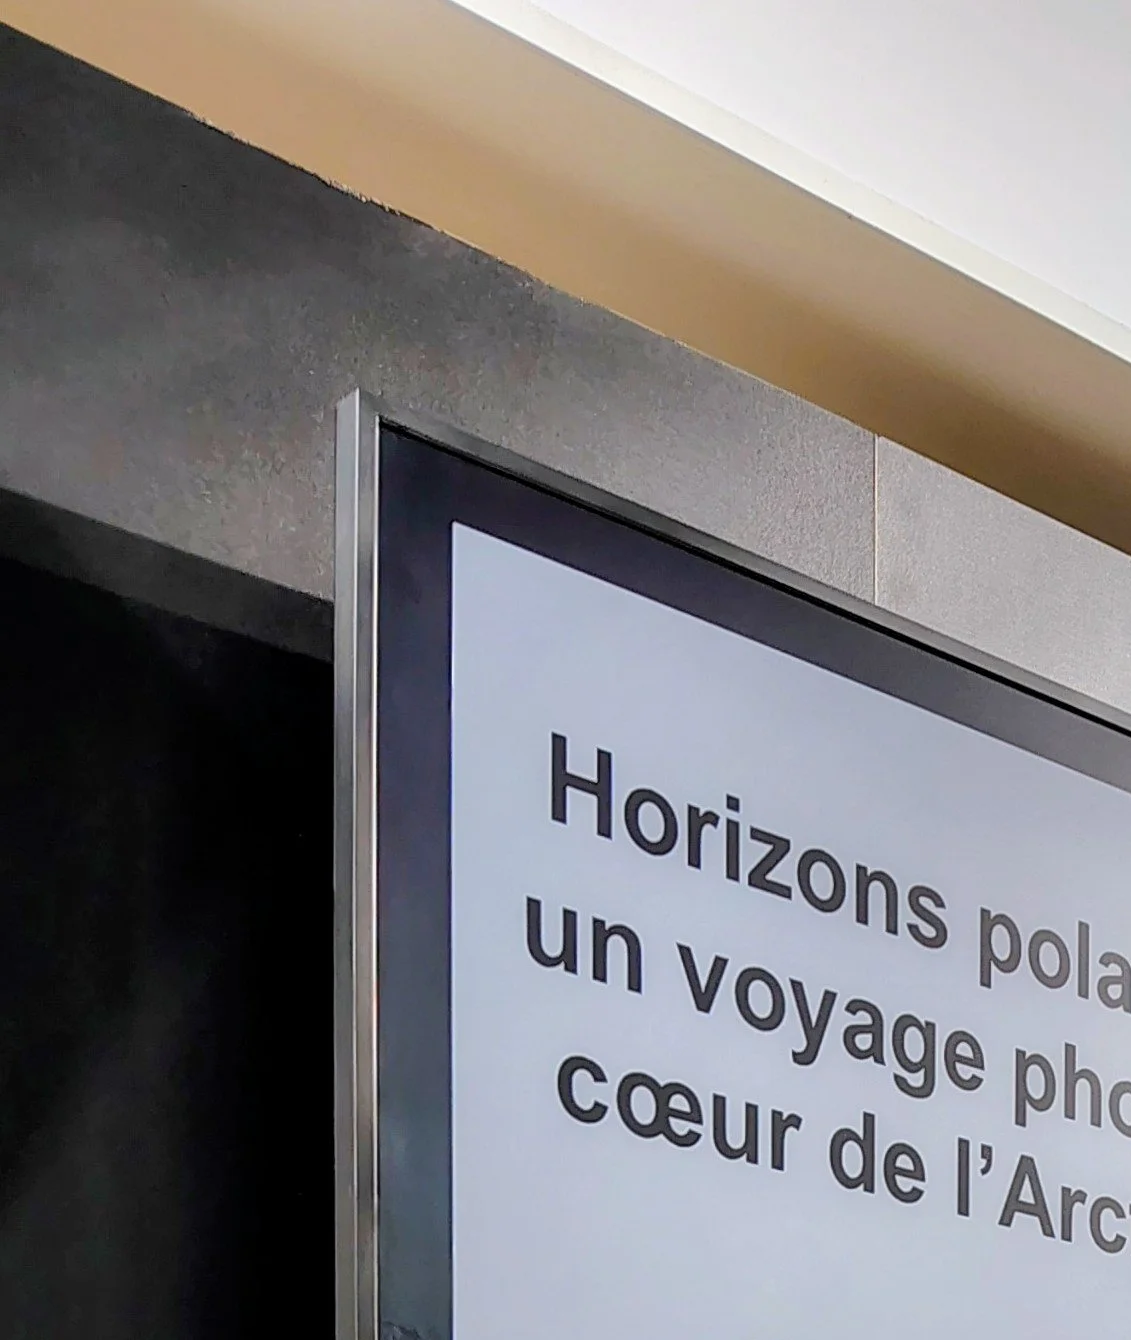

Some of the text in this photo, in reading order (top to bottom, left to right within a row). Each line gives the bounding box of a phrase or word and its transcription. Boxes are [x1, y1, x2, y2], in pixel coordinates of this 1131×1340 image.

[550, 731, 948, 950] Horizons
[525, 895, 643, 995] un
[675, 942, 986, 1100] voyage
[556, 1055, 803, 1172] cœur
[828, 1110, 927, 1205] de
